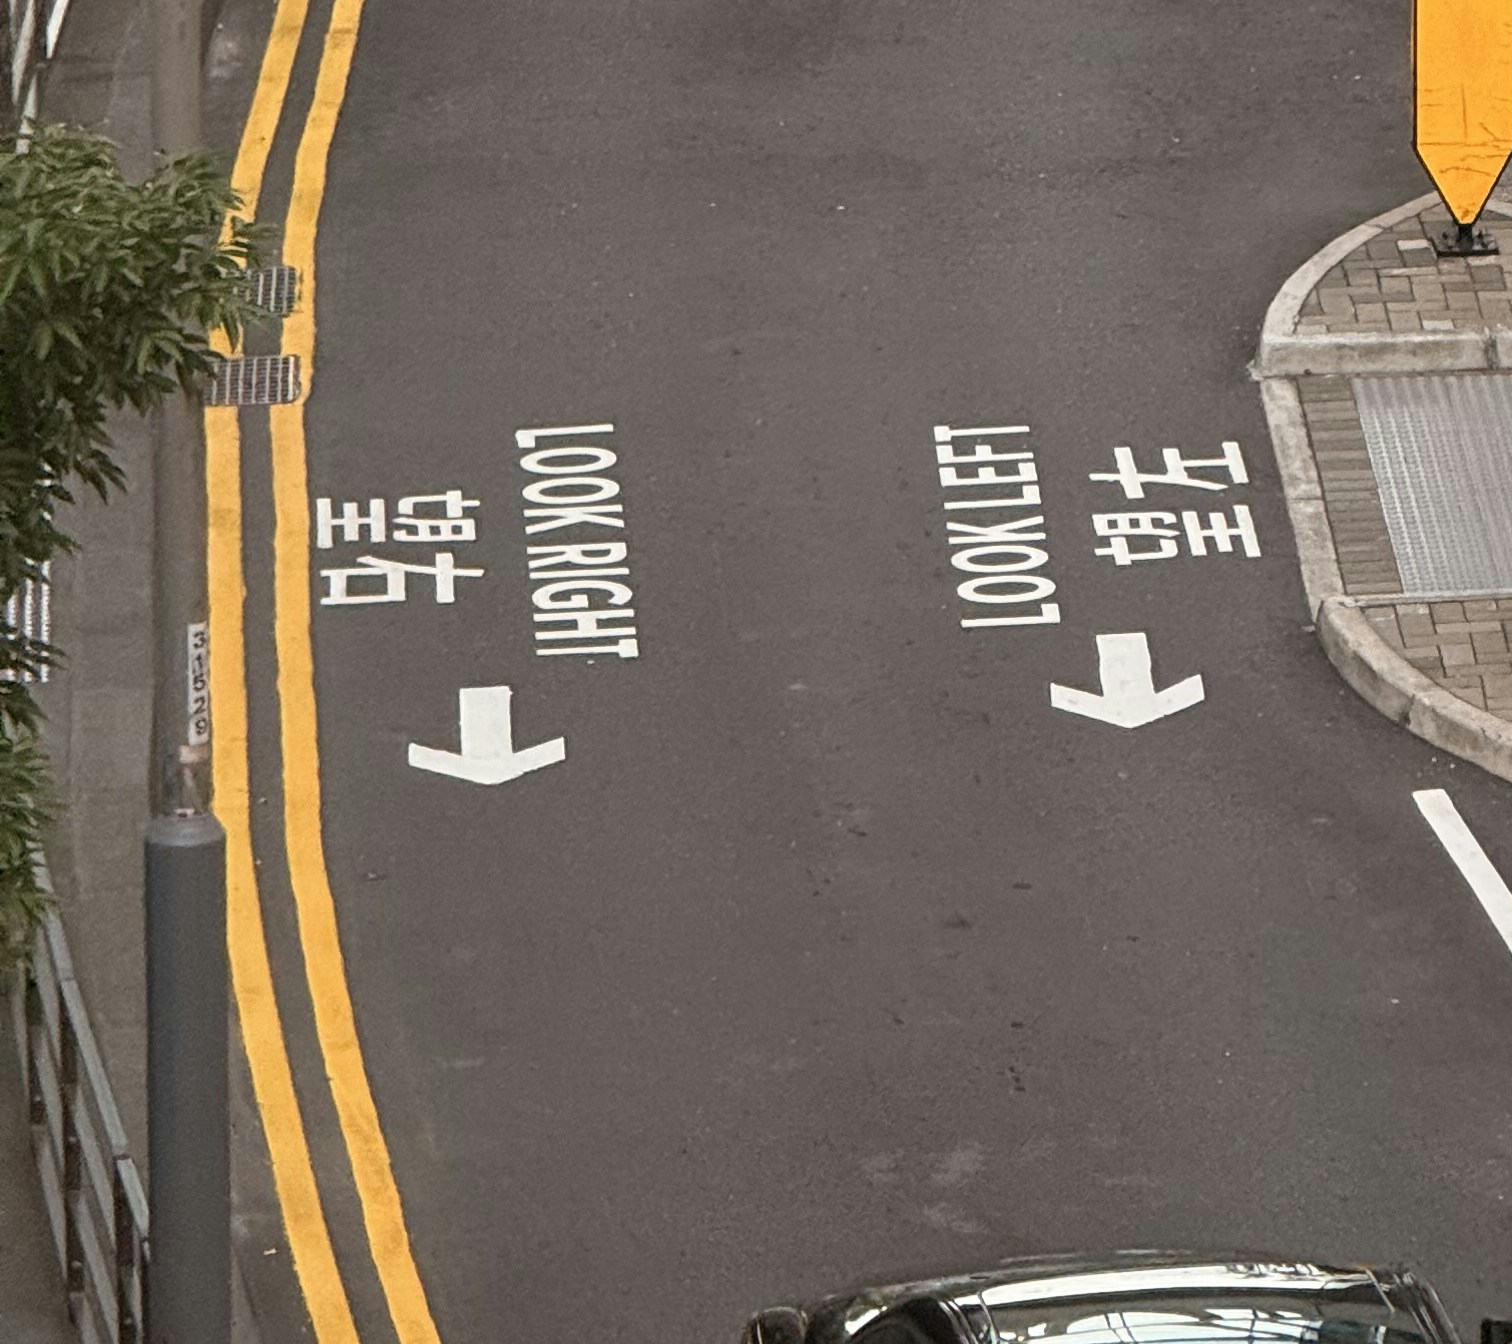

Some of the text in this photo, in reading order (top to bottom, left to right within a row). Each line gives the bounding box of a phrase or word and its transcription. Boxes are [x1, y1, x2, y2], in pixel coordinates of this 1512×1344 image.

[316, 490, 484, 605] 望右
[515, 423, 639, 658] LOOK RIGHT
[933, 425, 1061, 628] LOOK LEFT
[1088, 441, 1262, 566] 望左
